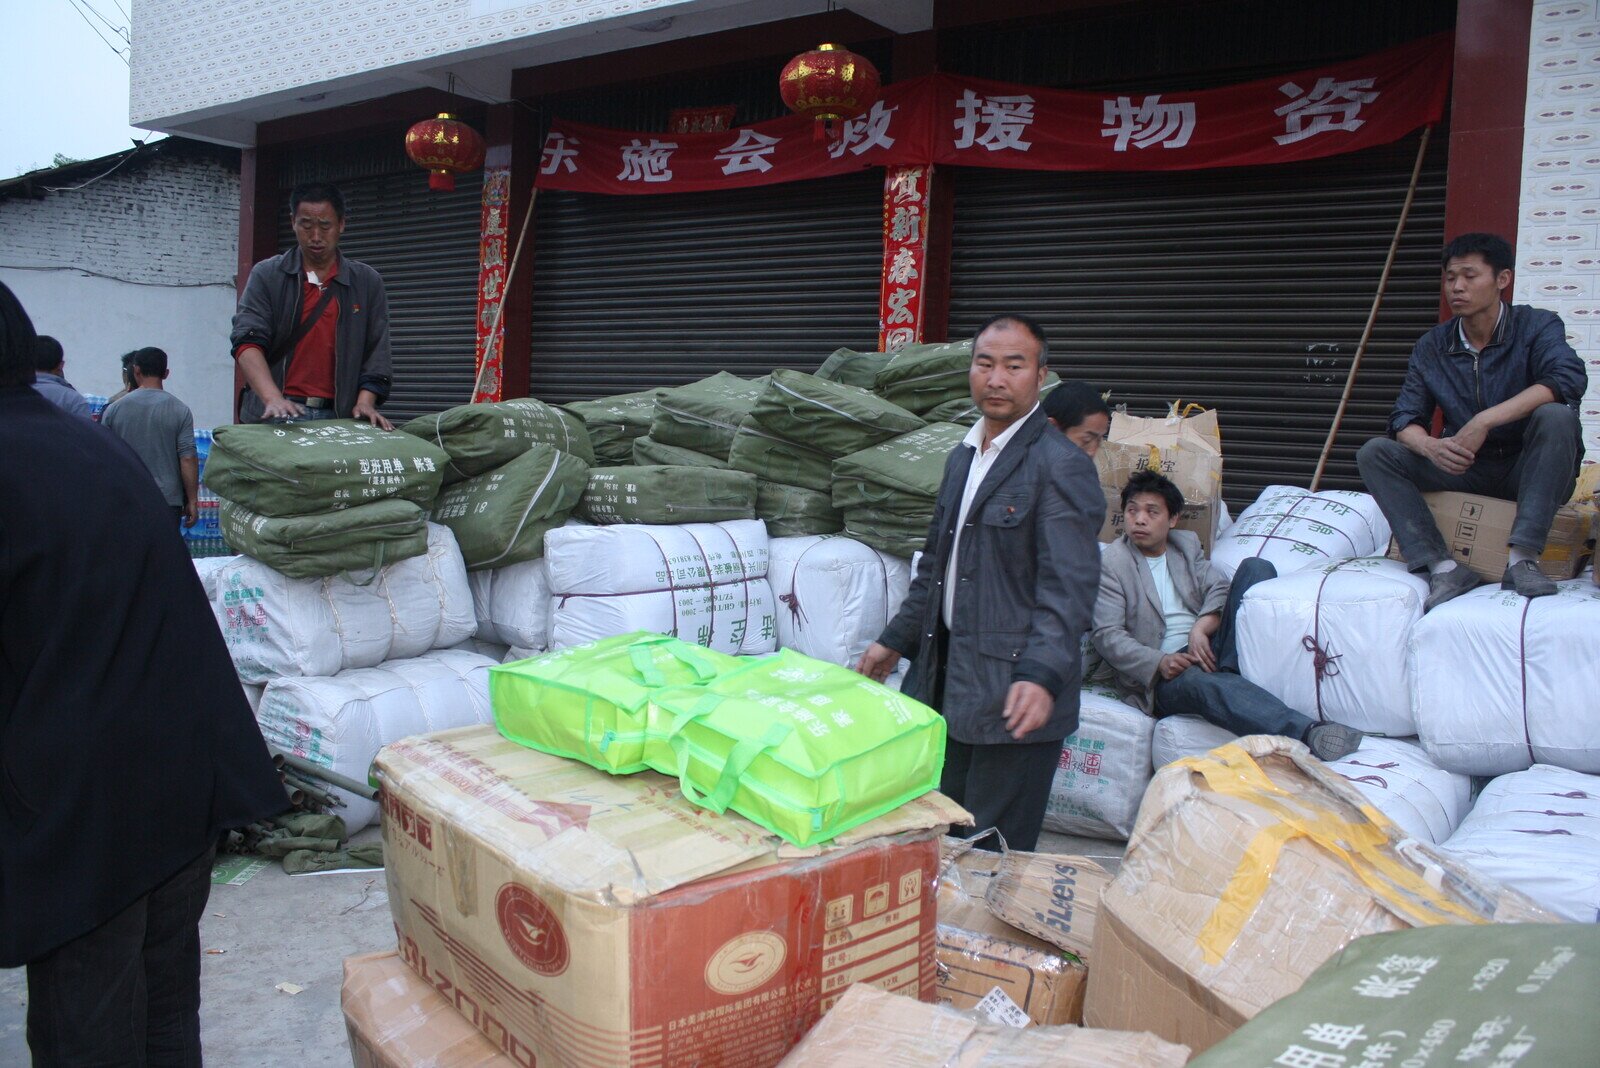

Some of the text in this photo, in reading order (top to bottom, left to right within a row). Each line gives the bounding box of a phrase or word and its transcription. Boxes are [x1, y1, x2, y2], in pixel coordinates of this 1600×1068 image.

[359, 457, 405, 475] 型班用单
[1135, 458, 1176, 473] 护宝
